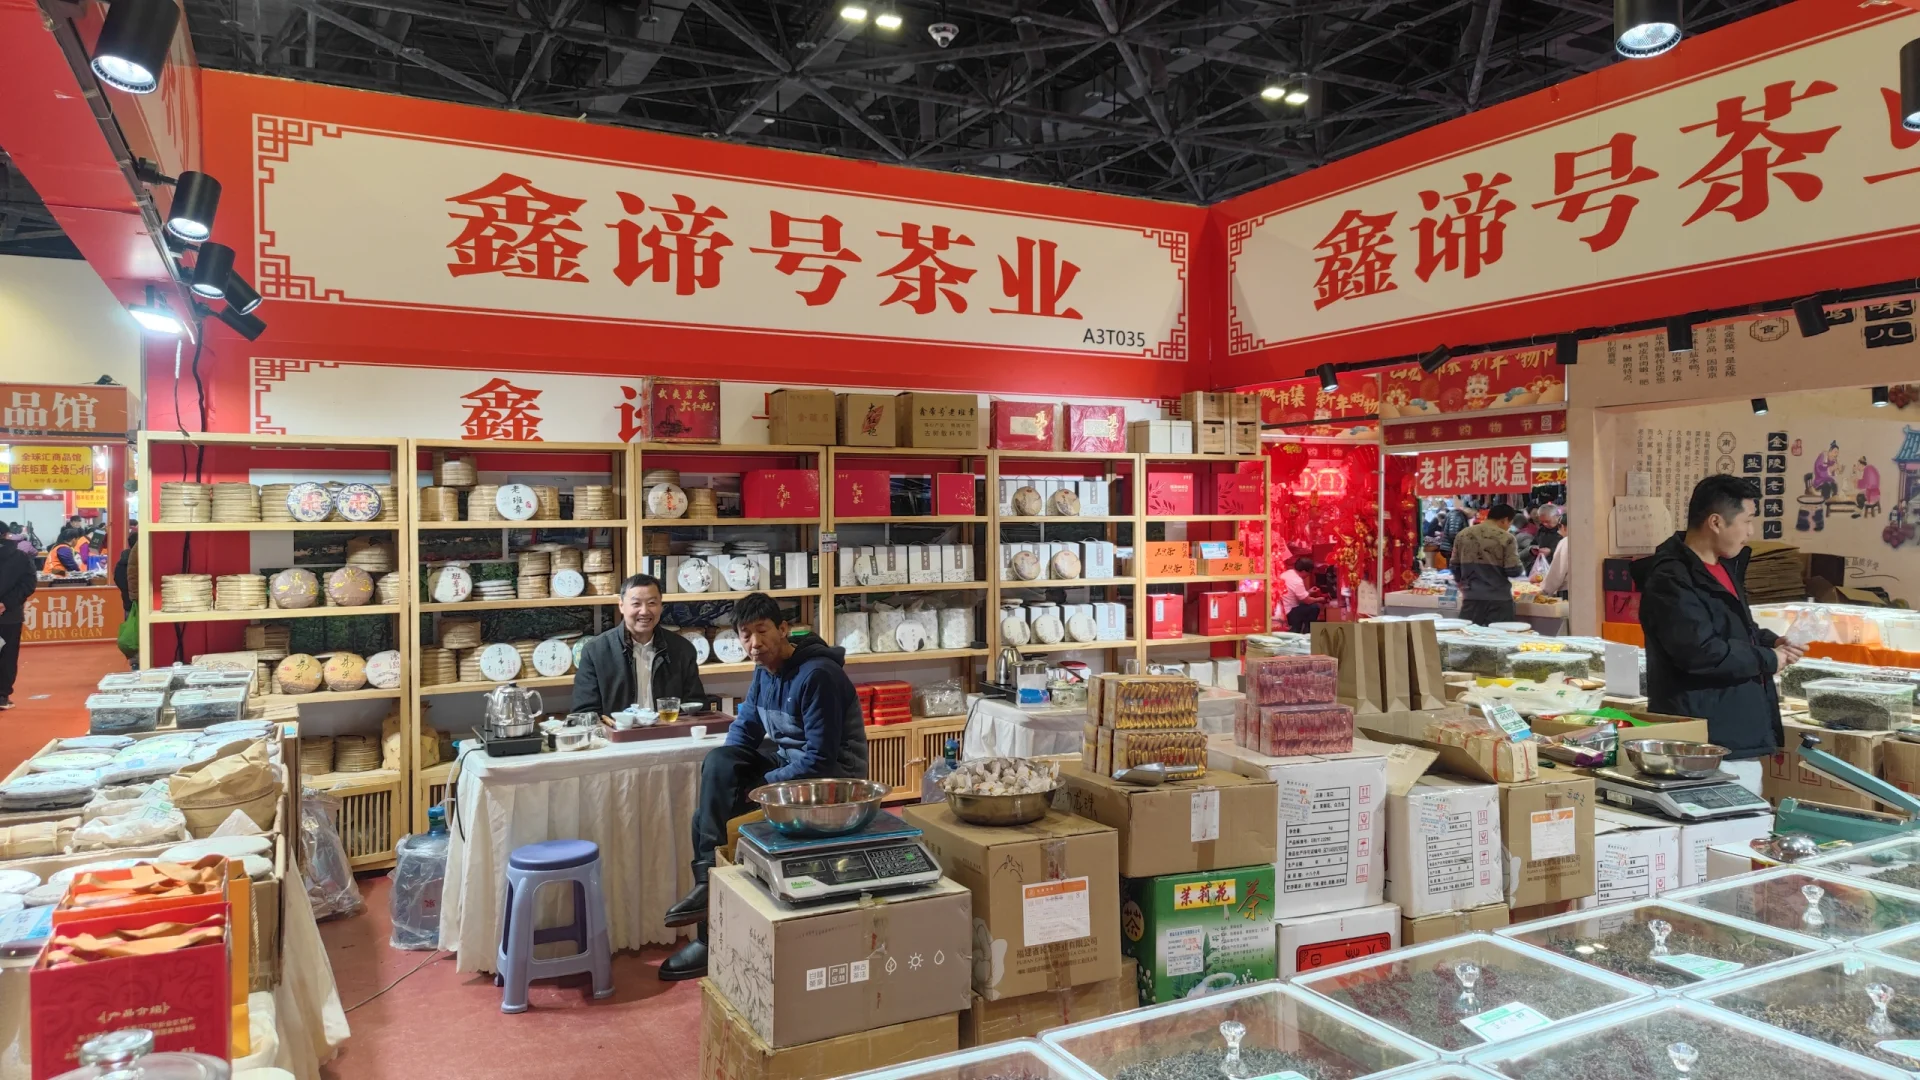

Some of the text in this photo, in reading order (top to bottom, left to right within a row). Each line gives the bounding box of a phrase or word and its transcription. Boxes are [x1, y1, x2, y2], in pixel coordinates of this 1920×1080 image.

[446, 171, 1084, 321] 鑫谛号茶业
[1083, 328, 1146, 350] A3T035
[4, 391, 99, 429] 品馆
[1403, 418, 1534, 441] 新年购物节
[22, 452, 82, 462] 全球汇商品馆
[1420, 450, 1528, 490] 老北京咯吱盒
[511, 485, 524, 515] 老班章
[1764, 435, 1788, 534] 金陵老味儿
[46, 628, 67, 638] PIN
[71, 627, 103, 637] GUAN
[1180, 878, 1269, 922] 茉莉花 茶
